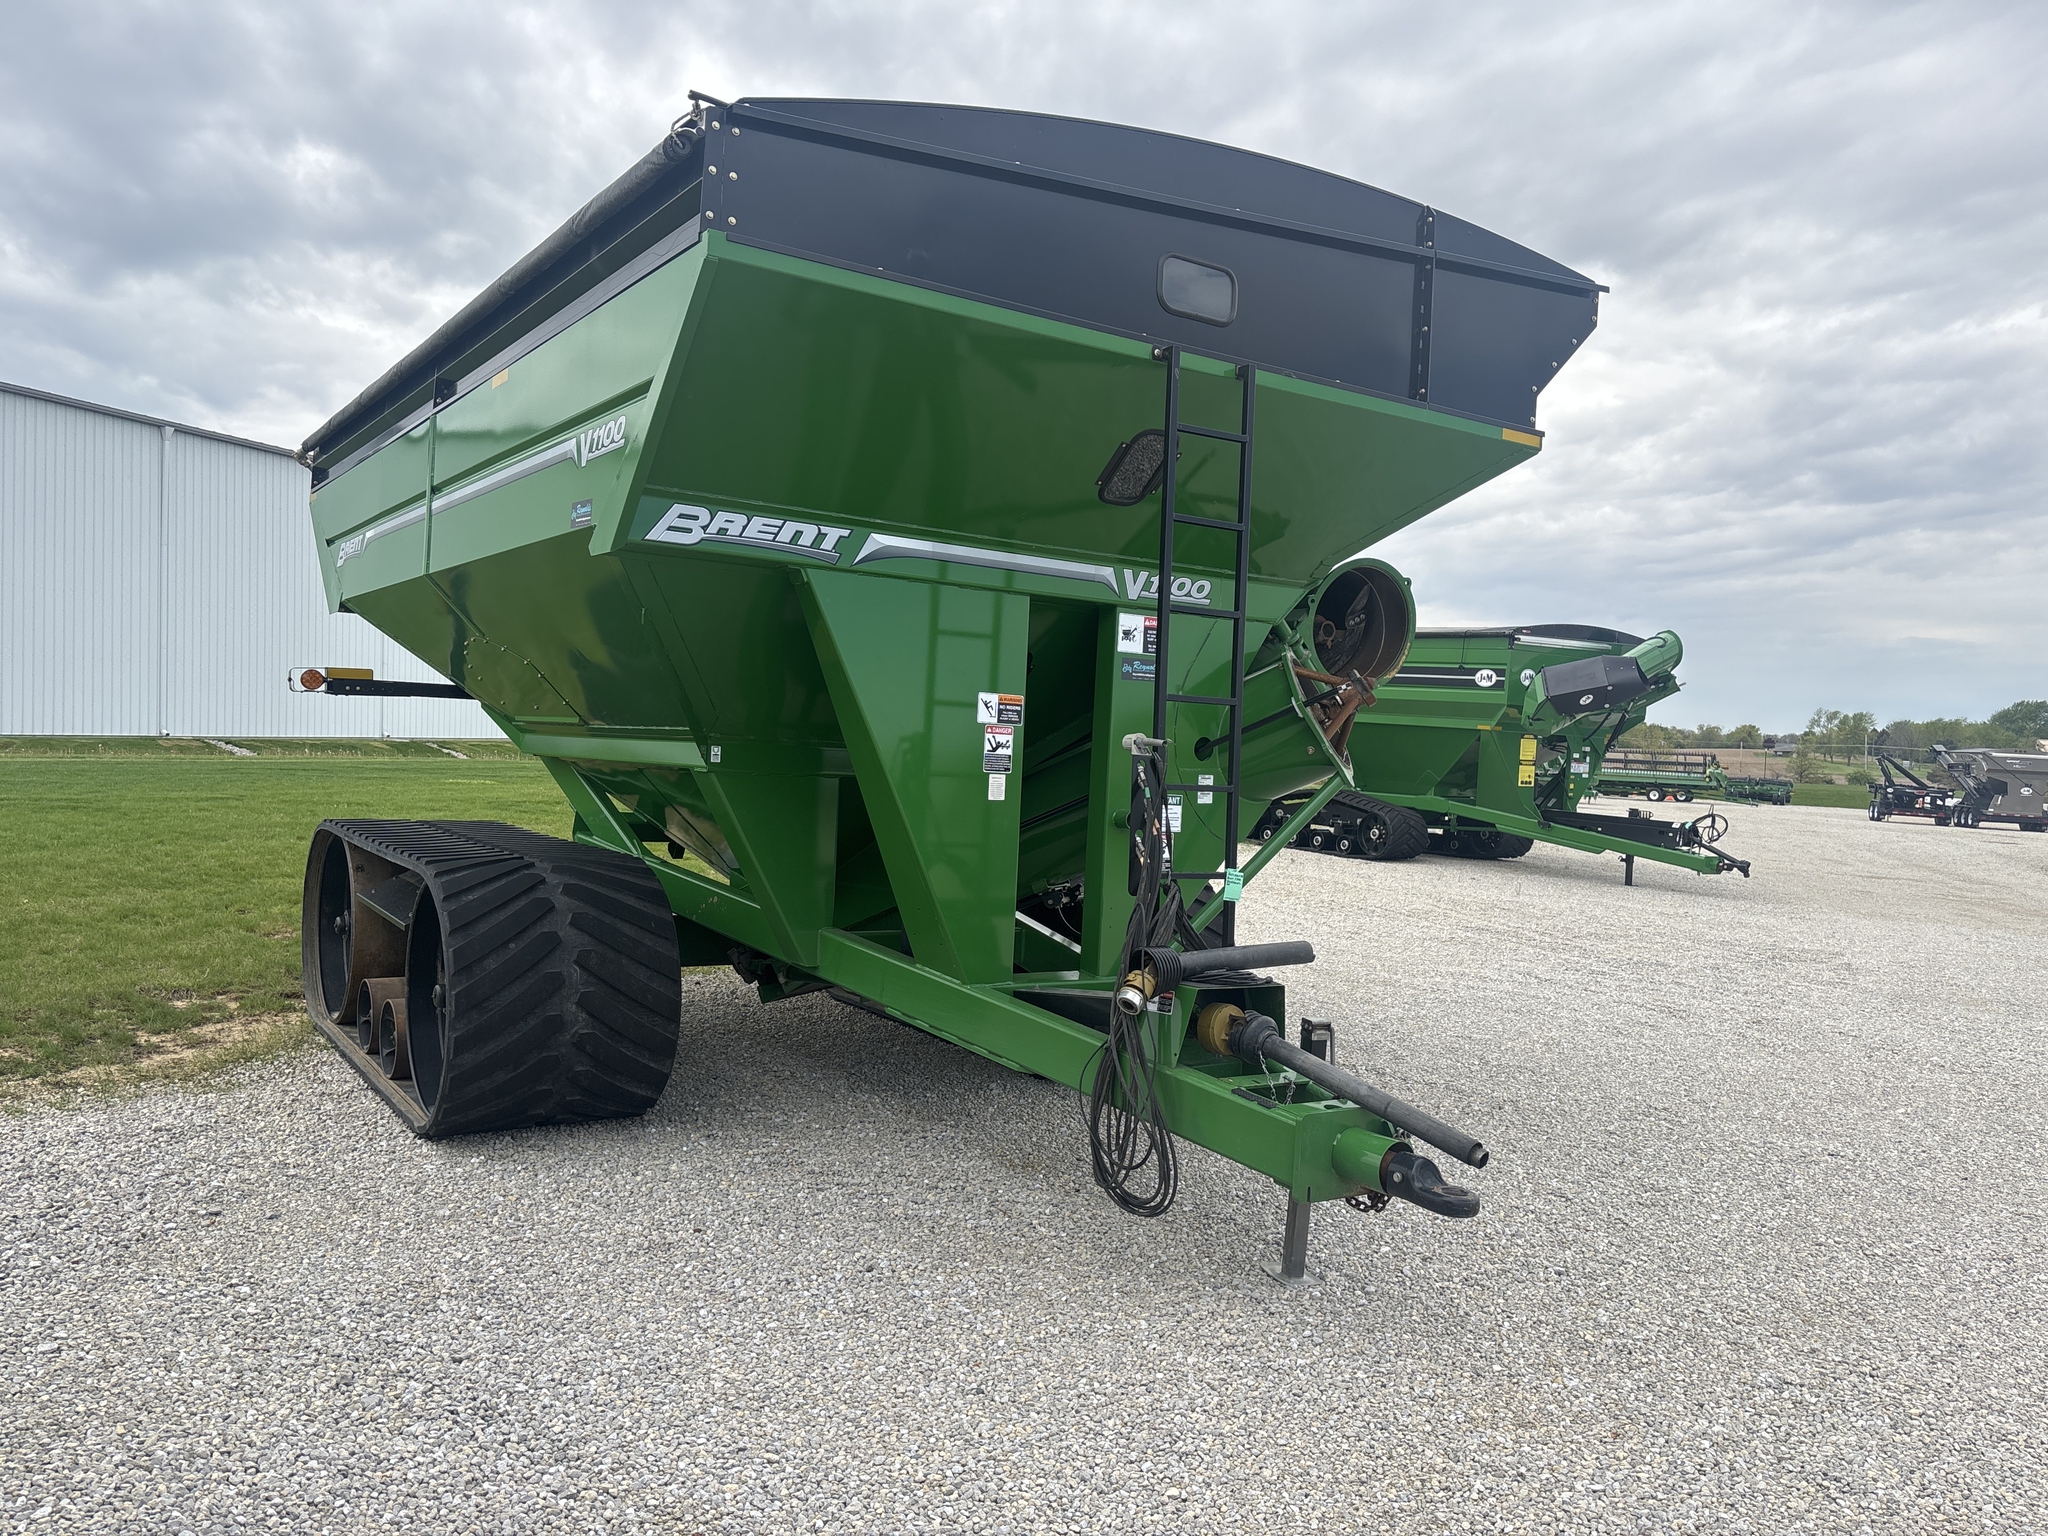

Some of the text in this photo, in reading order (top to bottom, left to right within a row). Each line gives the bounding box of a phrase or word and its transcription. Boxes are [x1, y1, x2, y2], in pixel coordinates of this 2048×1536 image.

[580, 415, 626, 467] V1100
[644, 503, 852, 552] BRENT
[337, 534, 363, 567] BRENT
[1123, 568, 1211, 600] V100
